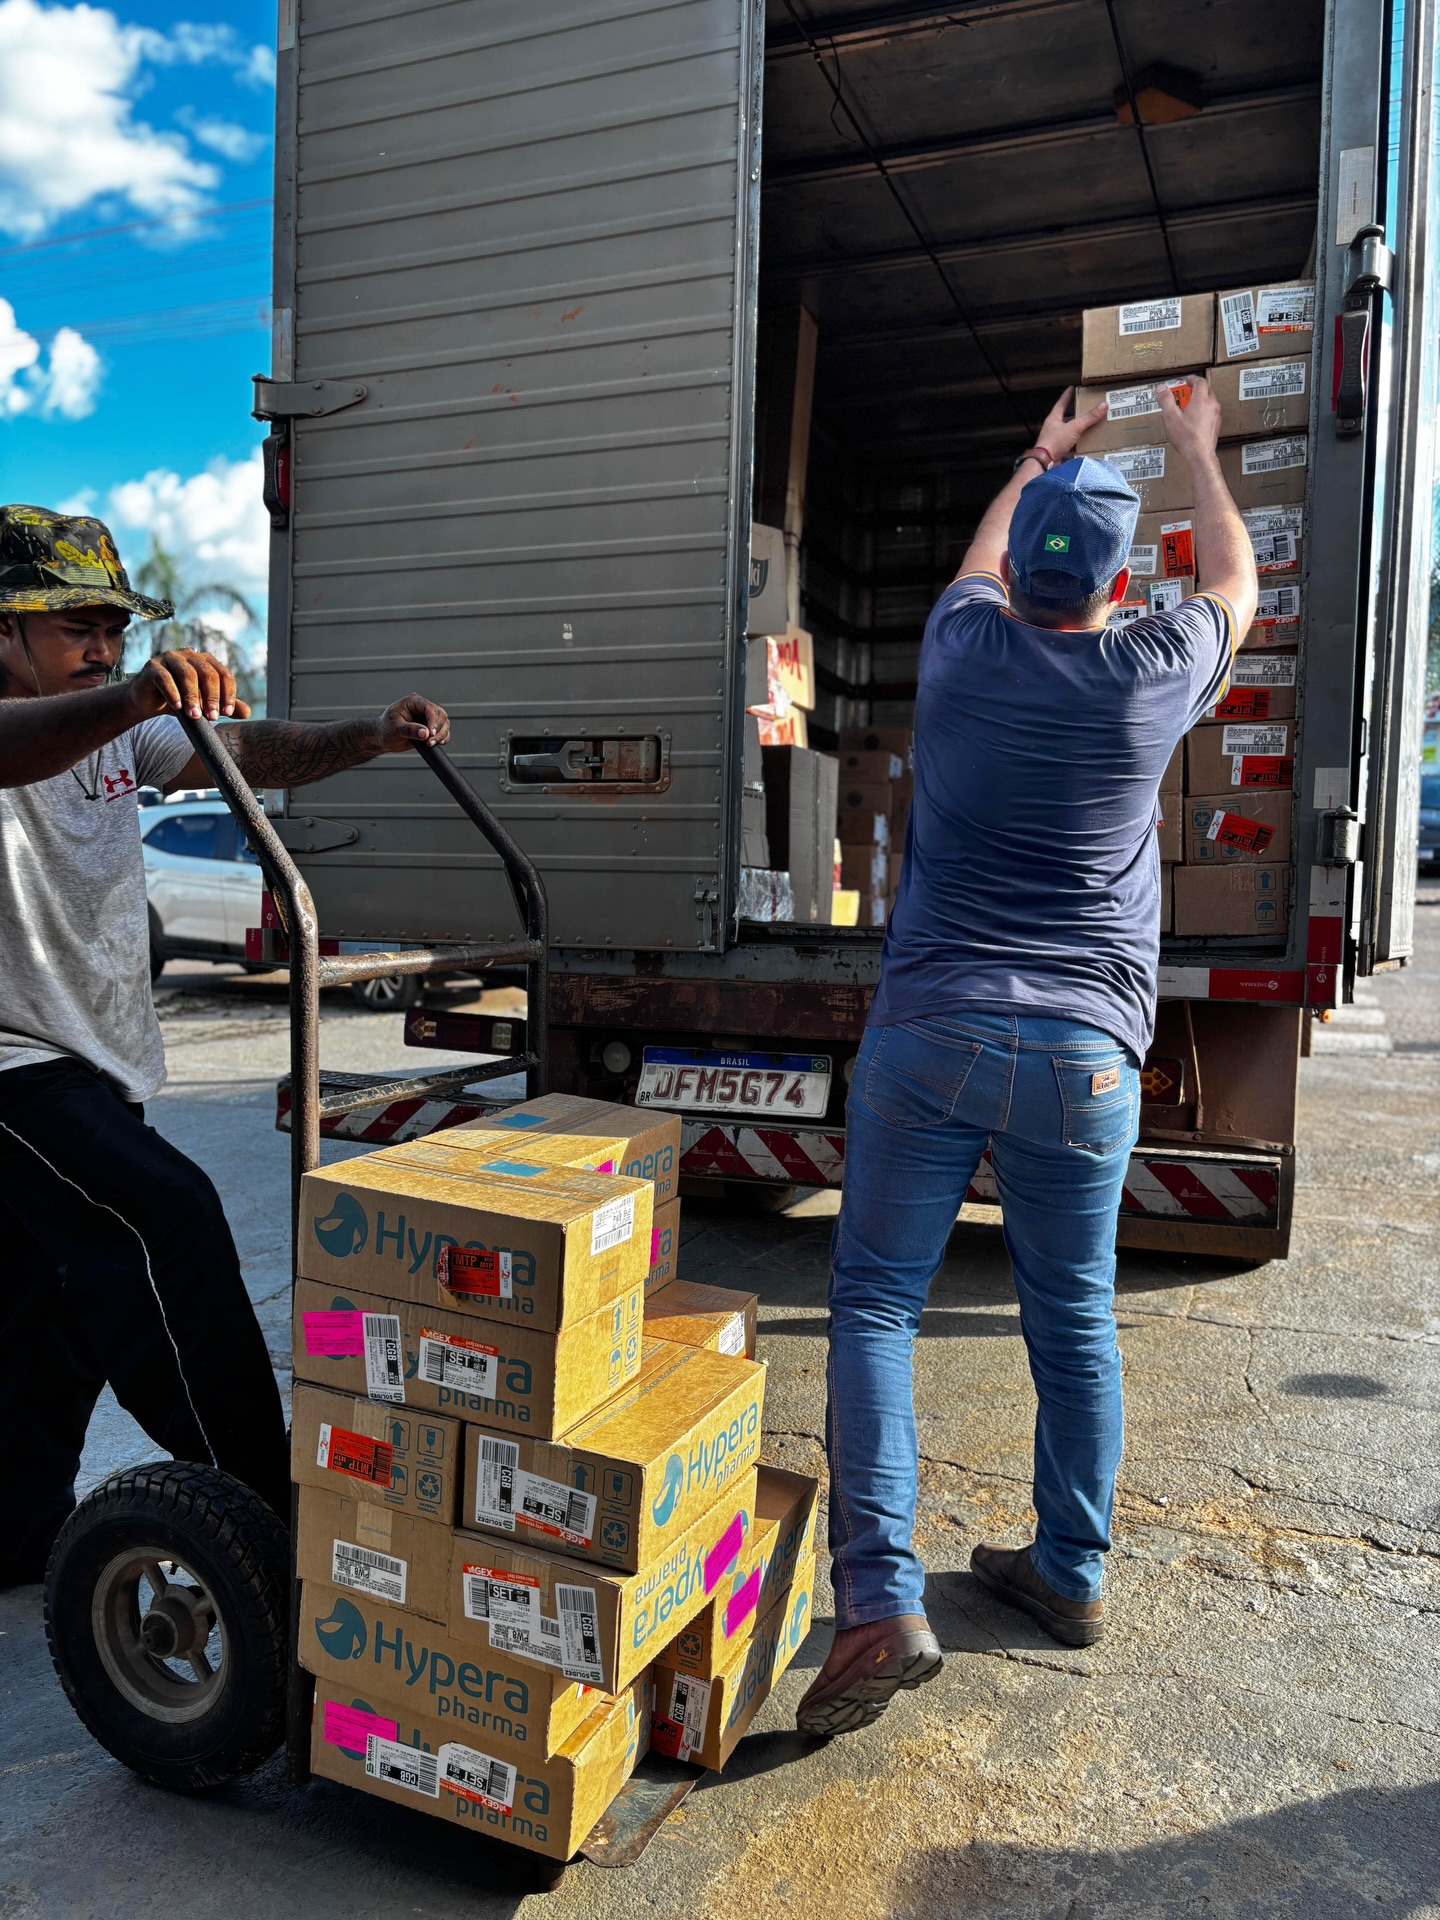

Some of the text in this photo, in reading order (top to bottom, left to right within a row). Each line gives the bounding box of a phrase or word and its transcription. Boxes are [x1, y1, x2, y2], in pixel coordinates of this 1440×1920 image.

[720, 1057, 750, 1067] BRASIL
[653, 1067, 806, 1108] DFM5G74
[641, 1091, 651, 1102] BR
[456, 1253, 477, 1267] MTP
[387, 1342, 397, 1361] CGB
[449, 1351, 471, 1367] SET
[473, 1362, 485, 1371] SET
[370, 1392, 393, 1400] SOLIDEZ
[686, 1401, 758, 1494] Hypera
[349, 1461, 369, 1474] MTP
[716, 1439, 755, 1493] pharma
[501, 1469, 512, 1489] CGB
[525, 1499, 537, 1508] SET
[540, 1505, 562, 1521] SET
[477, 1516, 503, 1527] SOLIDEZ
[354, 1566, 370, 1579] PW8
[635, 1540, 687, 1606] pharma
[493, 1586, 513, 1601] SET
[516, 1595, 528, 1604] SET
[582, 1616, 593, 1637] CGB
[512, 1630, 529, 1643] PW8
[374, 1620, 529, 1714] Hypera
[565, 1669, 590, 1679] SOLIDEZ
[438, 1696, 527, 1742] pharma
[674, 1703, 685, 1721] CGB
[381, 1763, 391, 1772] SET
[449, 1765, 461, 1773] SET
[400, 1770, 416, 1784] CGB
[462, 1771, 484, 1788] SET
